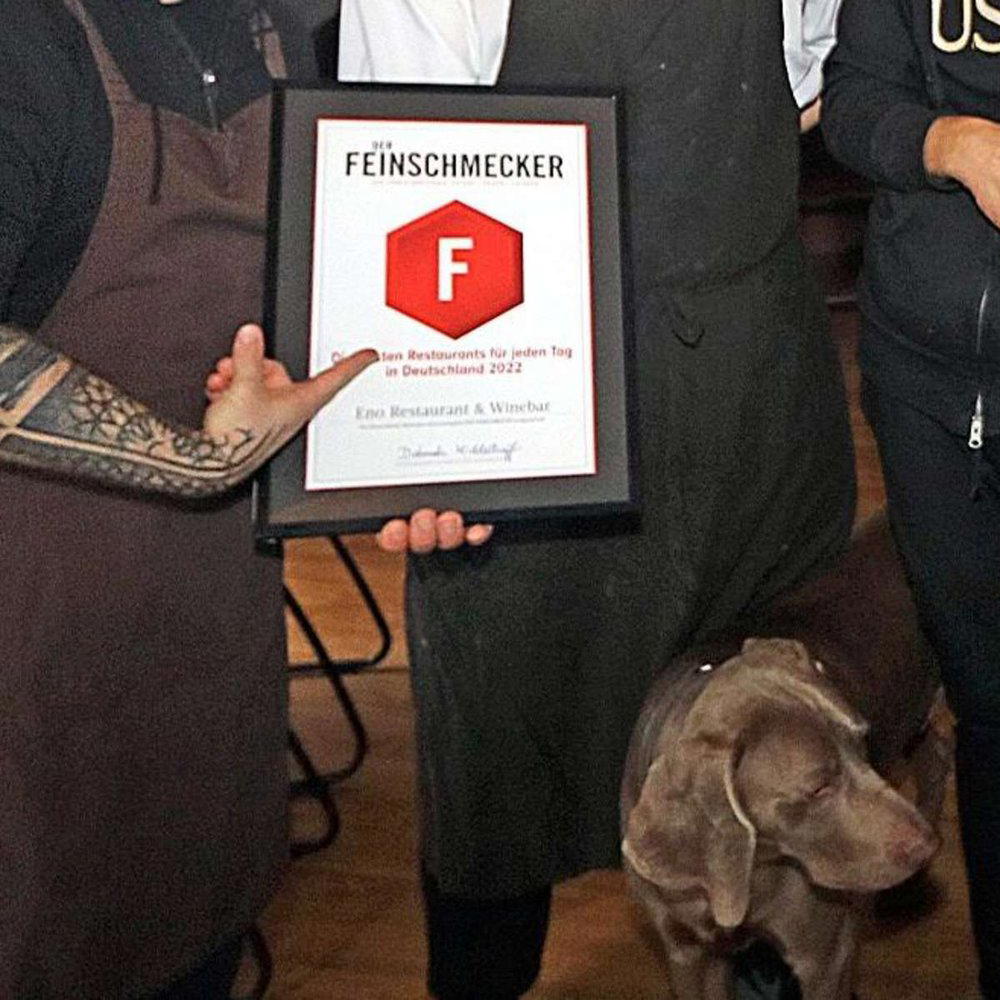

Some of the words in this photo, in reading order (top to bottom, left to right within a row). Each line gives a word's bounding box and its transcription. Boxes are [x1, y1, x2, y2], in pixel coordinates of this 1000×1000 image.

[345, 151, 564, 179] FEINSCHMECKER
[438, 236, 474, 302] F
[407, 348, 486, 361] Restaurants
[489, 346, 507, 359] für
[511, 345, 547, 360] jeden
[552, 344, 573, 359] Tag
[385, 364, 398, 377] in
[402, 363, 485, 377] Deutschland
[489, 361, 523, 375] 2022
[355, 405, 386, 420] Eno
[389, 402, 469, 419] Restaurant
[474, 402, 486, 415] &
[490, 400, 551, 415] Winebar
